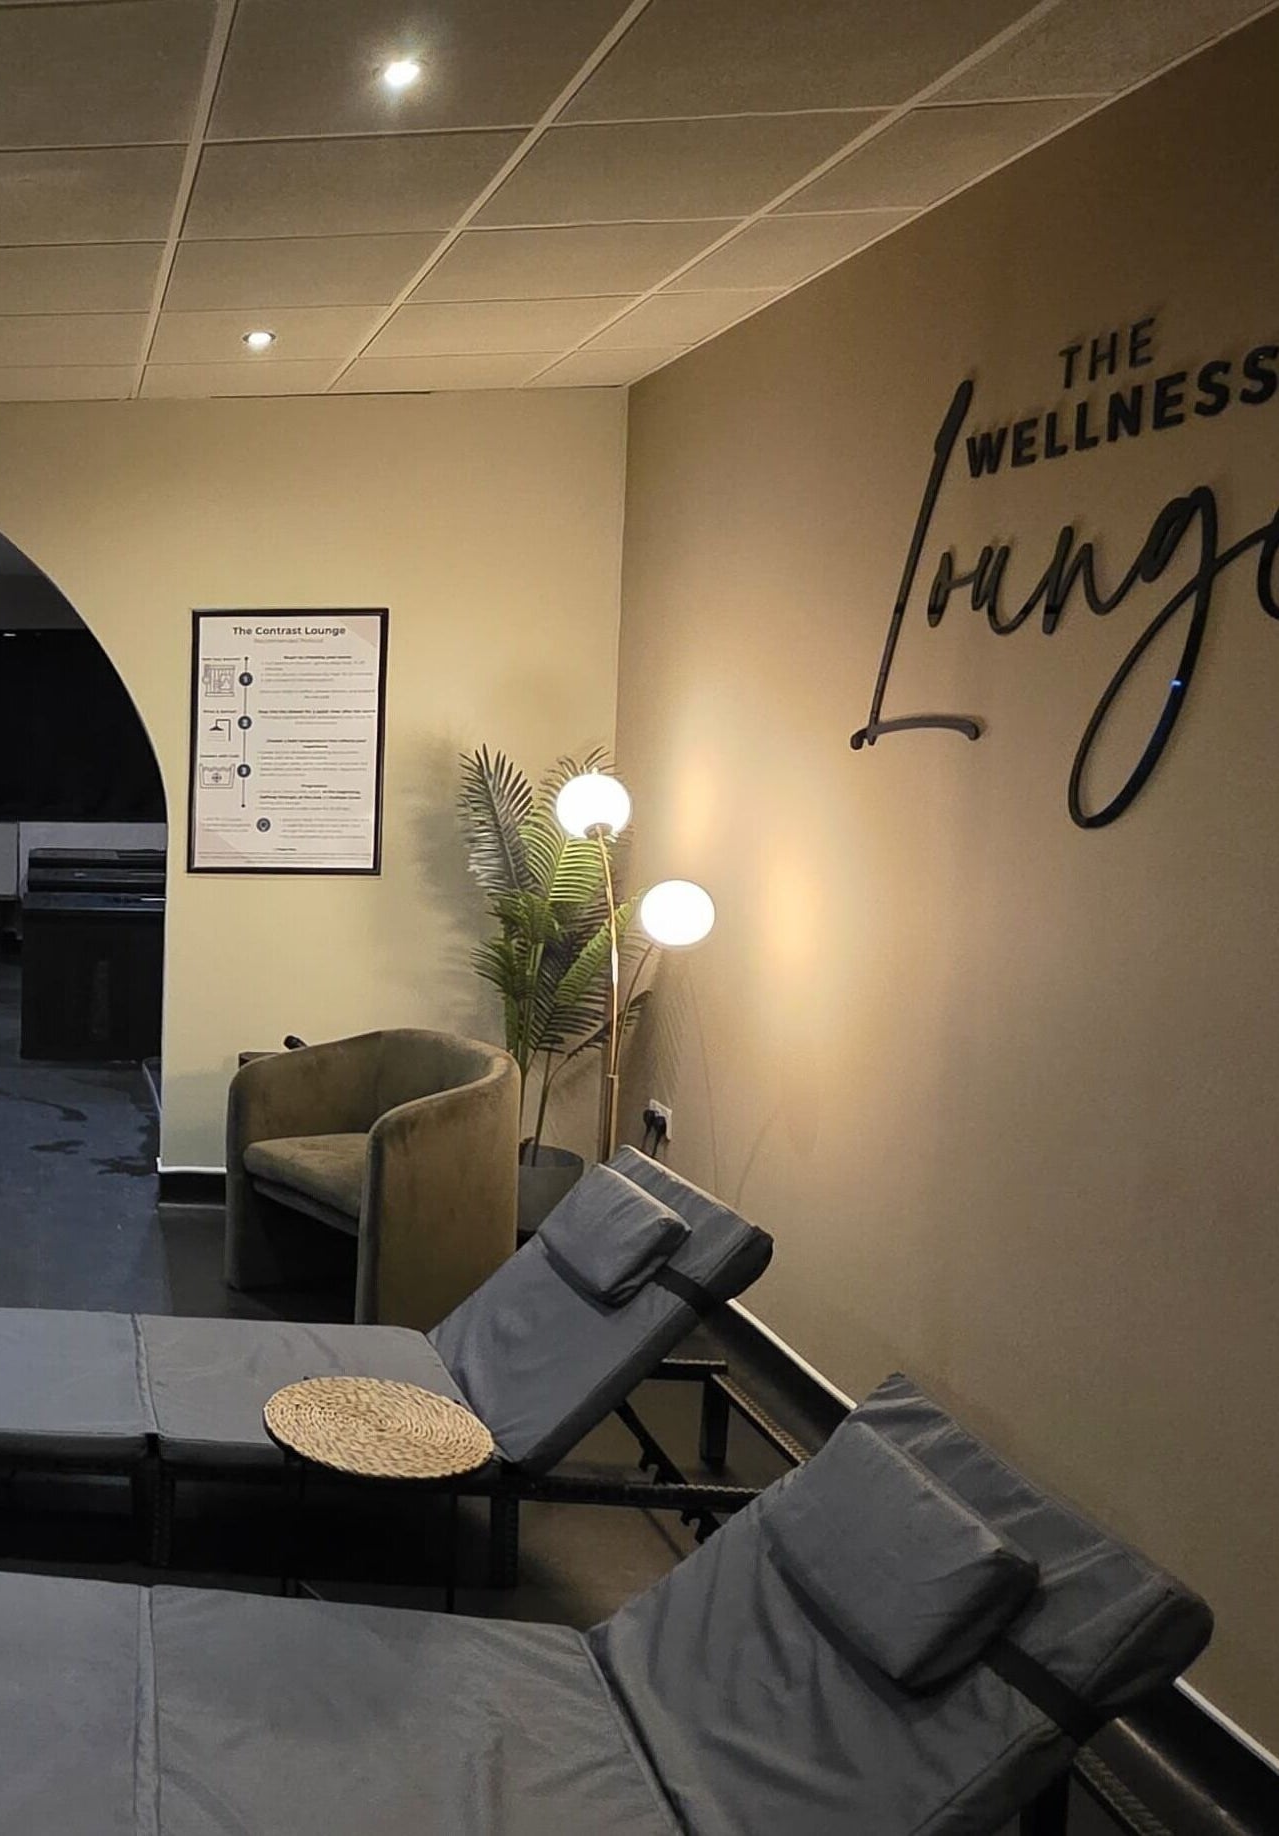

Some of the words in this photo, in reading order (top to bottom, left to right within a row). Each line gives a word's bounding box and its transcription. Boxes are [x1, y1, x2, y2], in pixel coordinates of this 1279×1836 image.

[1058, 318, 1155, 389] THE
[966, 345, 1279, 478] WELLNESS
[233, 627, 252, 635] The
[255, 627, 301, 635] Contrast
[305, 627, 346, 637] Lounge
